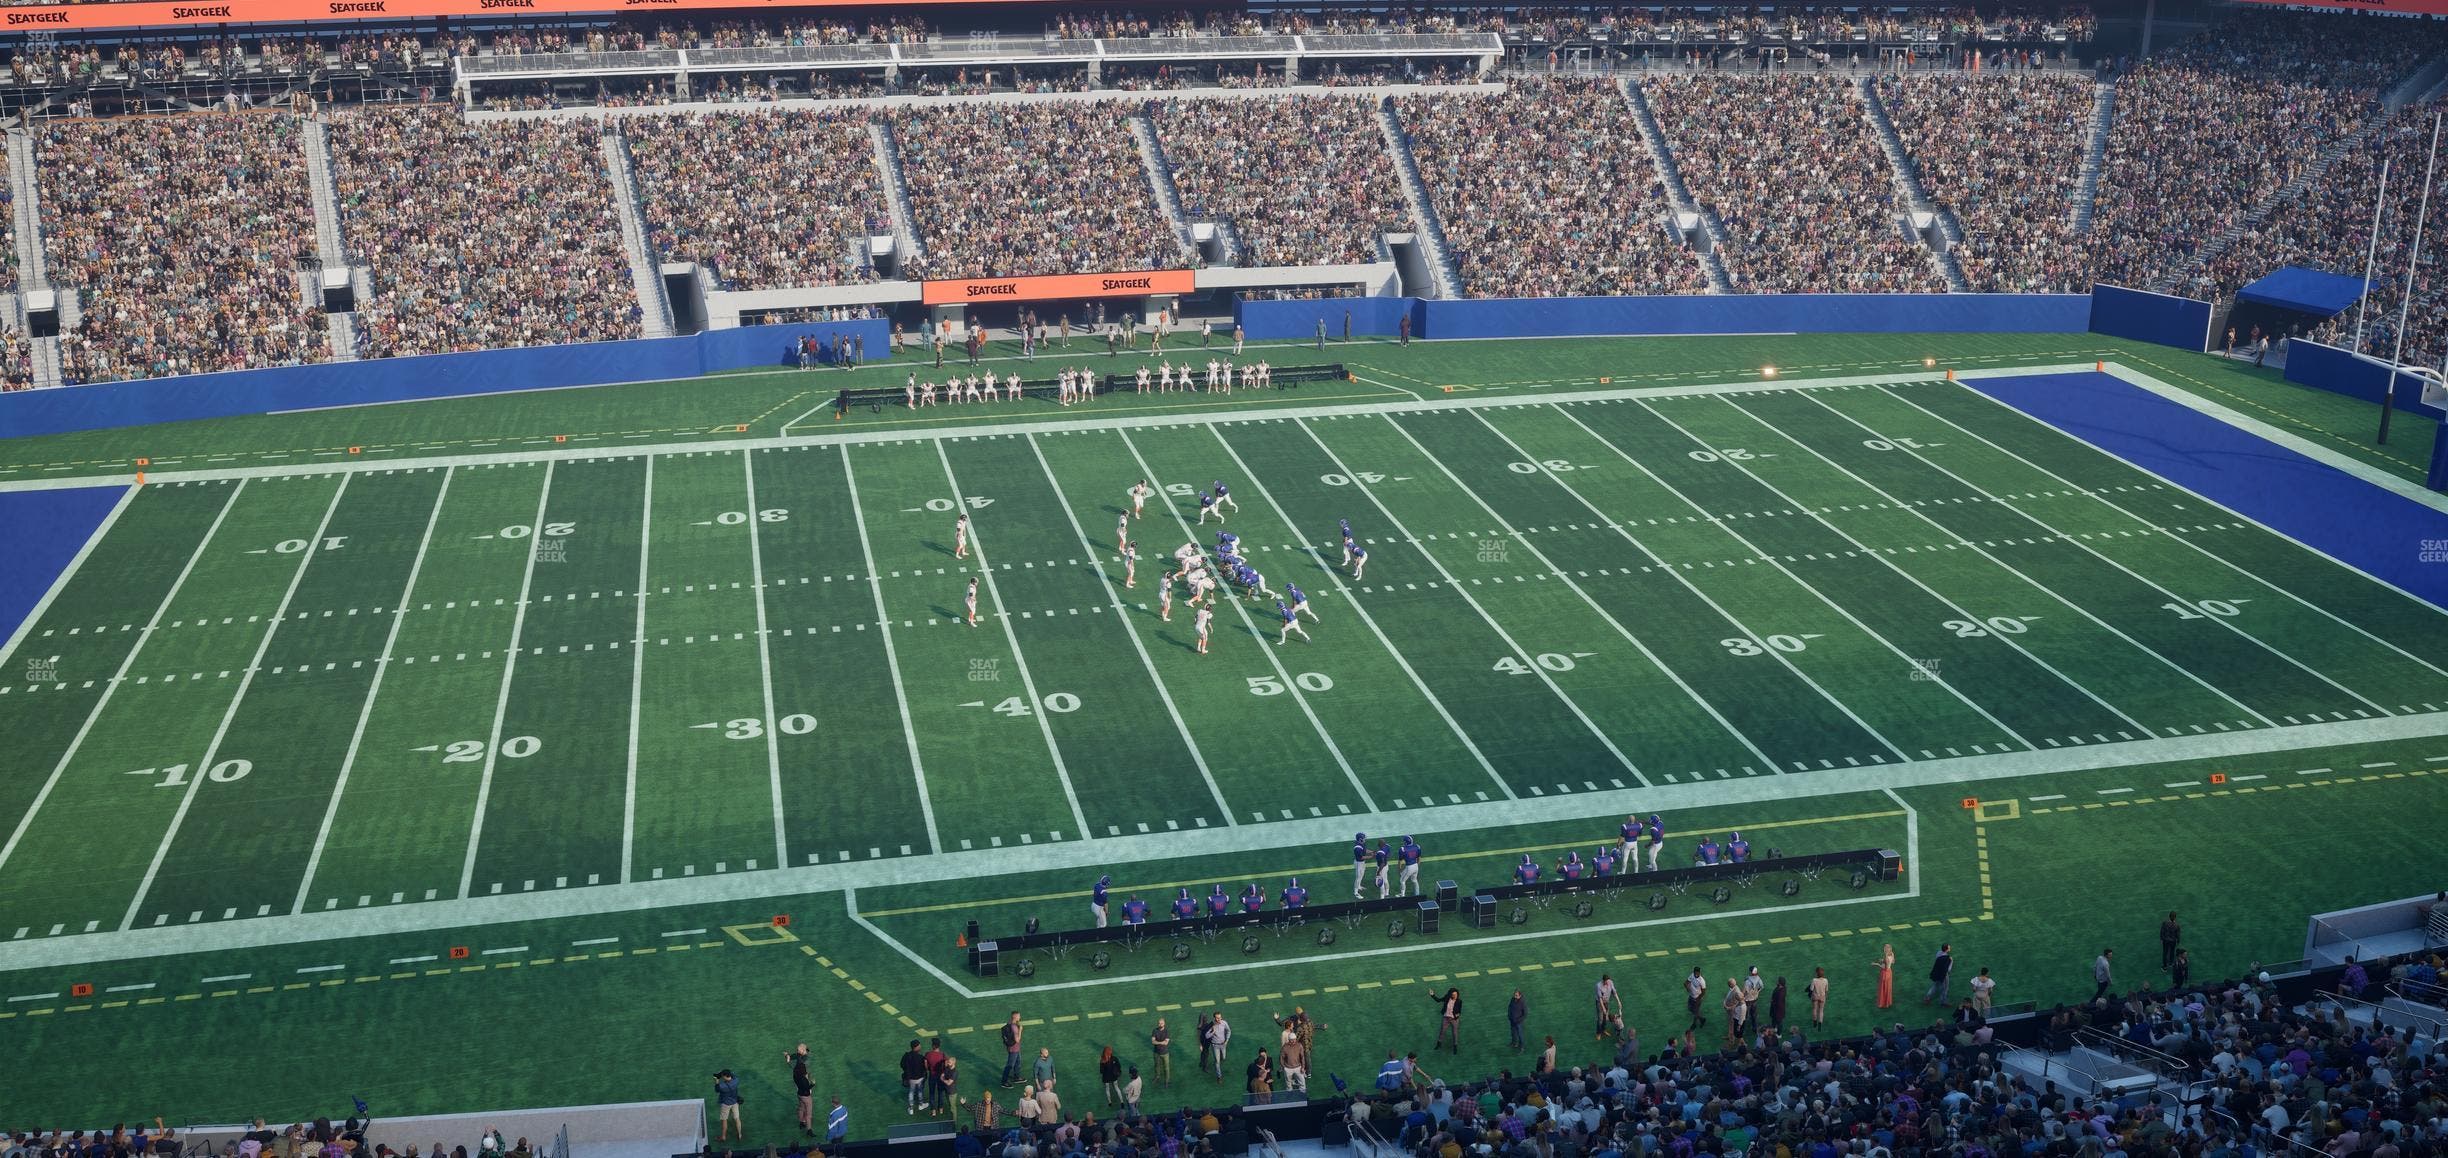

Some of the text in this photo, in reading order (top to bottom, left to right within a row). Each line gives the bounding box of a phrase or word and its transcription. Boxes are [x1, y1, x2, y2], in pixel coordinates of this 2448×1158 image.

[173, 6, 232, 18] SEATGEEK
[330, 1, 386, 13] SEATGEEK
[8, 12, 70, 24] SEATGEEK
[967, 284, 1017, 297] SEATGEEK
[1103, 277, 1151, 291] SEATGEEK
[1863, 438, 1925, 451] 10
[1688, 449, 1755, 462] 20
[1507, 460, 1575, 474] 30
[1320, 471, 1387, 486] 40
[926, 496, 995, 511] 40
[717, 509, 789, 525] 30
[500, 522, 576, 539] 20
[274, 536, 349, 553] 10
[2161, 600, 2240, 619] 10
[1942, 617, 2027, 637] 20
[1720, 634, 1806, 656] 30
[1493, 653, 1575, 675] 40
[1246, 672, 1333, 696] 50
[992, 693, 1081, 716] 40
[725, 714, 817, 740] 30
[442, 736, 542, 763] 20
[154, 759, 252, 787] 10
[777, 916, 786, 925] 30
[455, 948, 464, 956] 20
[78, 985, 86, 994] 10
